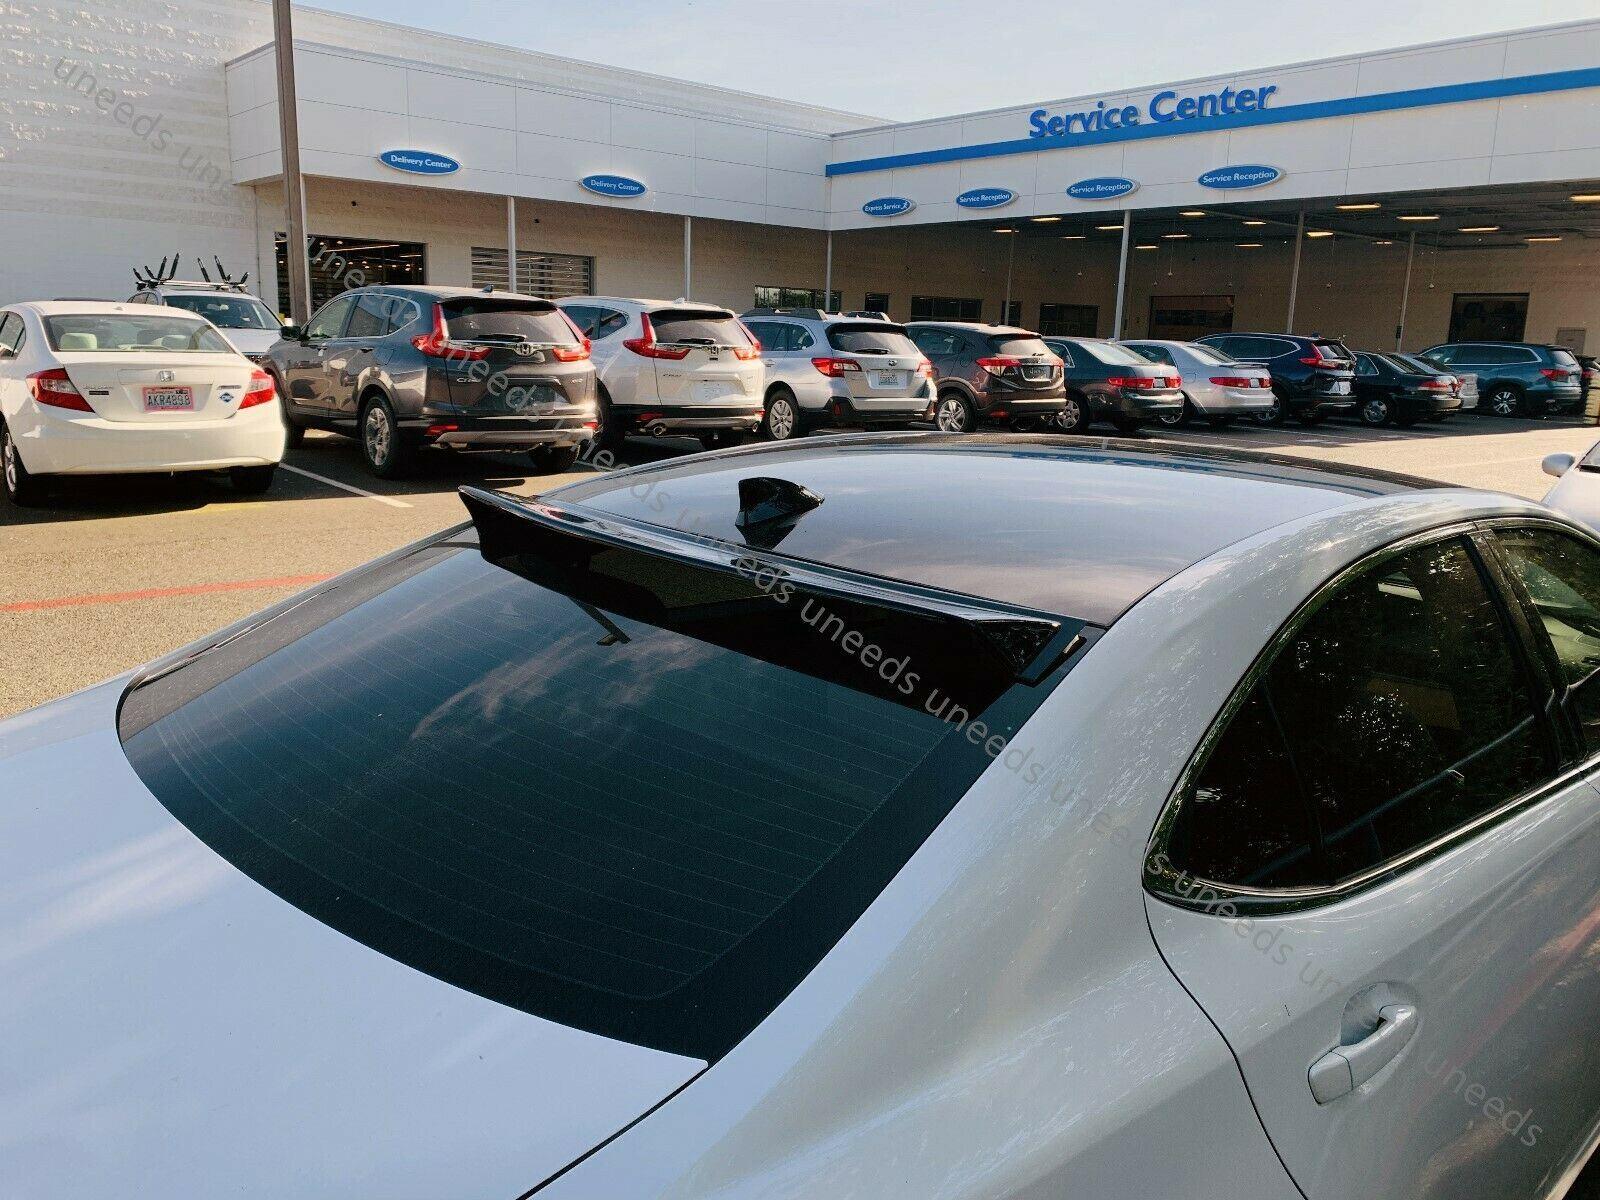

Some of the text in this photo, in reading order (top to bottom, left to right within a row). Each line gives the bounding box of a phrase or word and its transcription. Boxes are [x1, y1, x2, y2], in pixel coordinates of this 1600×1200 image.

[1029, 84, 1277, 138] Service Center
[390, 154, 452, 168] Delivery Center
[1203, 171, 1275, 184] Service Reception
[590, 180, 640, 191] Delivery Center
[1070, 182, 1131, 194] Service Reception
[959, 193, 1010, 203] Service Reception
[864, 204, 883, 213] Express
